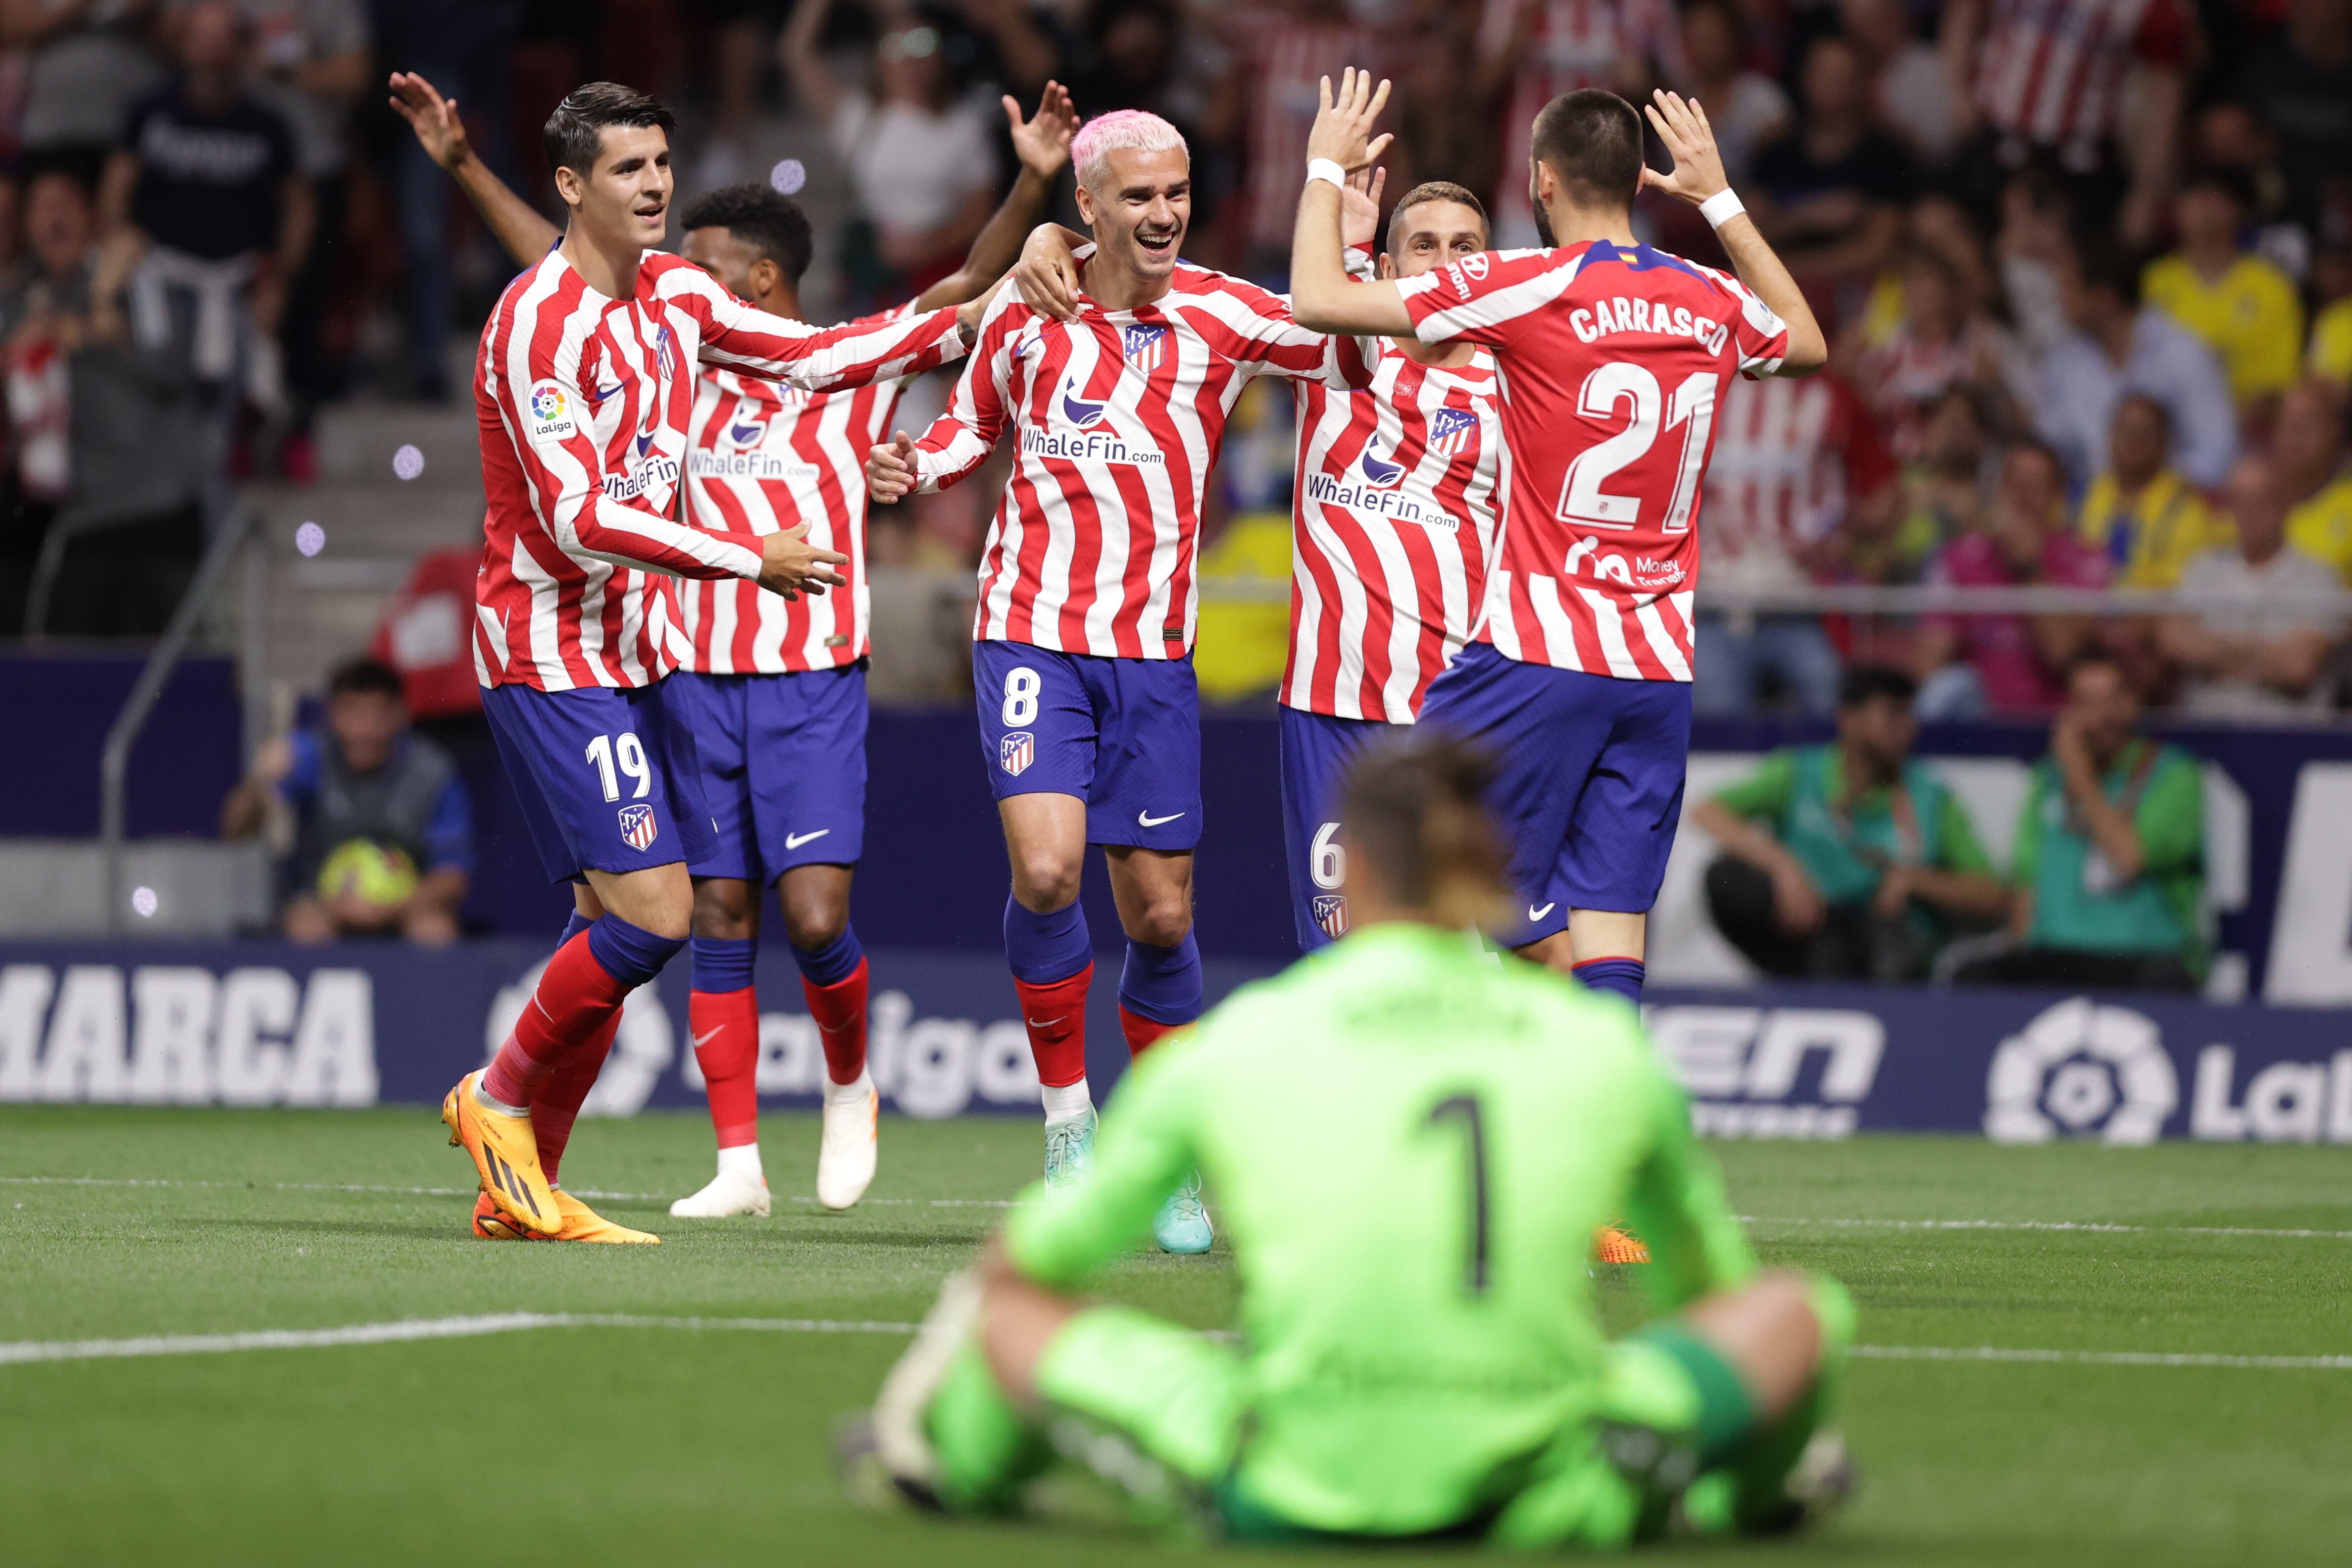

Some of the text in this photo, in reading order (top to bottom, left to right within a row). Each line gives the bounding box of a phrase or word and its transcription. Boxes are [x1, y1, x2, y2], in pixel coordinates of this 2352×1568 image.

[1569, 297, 1728, 357] CARRASCO
[536, 422, 571, 435] LaLiga
[1023, 428, 1161, 463] WhaleFin.com
[1555, 361, 1719, 534] 21
[690, 454, 816, 477] WhaleFin.com
[1308, 473, 1456, 529] WhaleFin.com
[1636, 556, 1680, 573] Money
[1002, 666, 1042, 728] 8
[585, 732, 651, 803] 19
[1310, 822, 1347, 890] 6
[1417, 1091, 1491, 1300] 1
